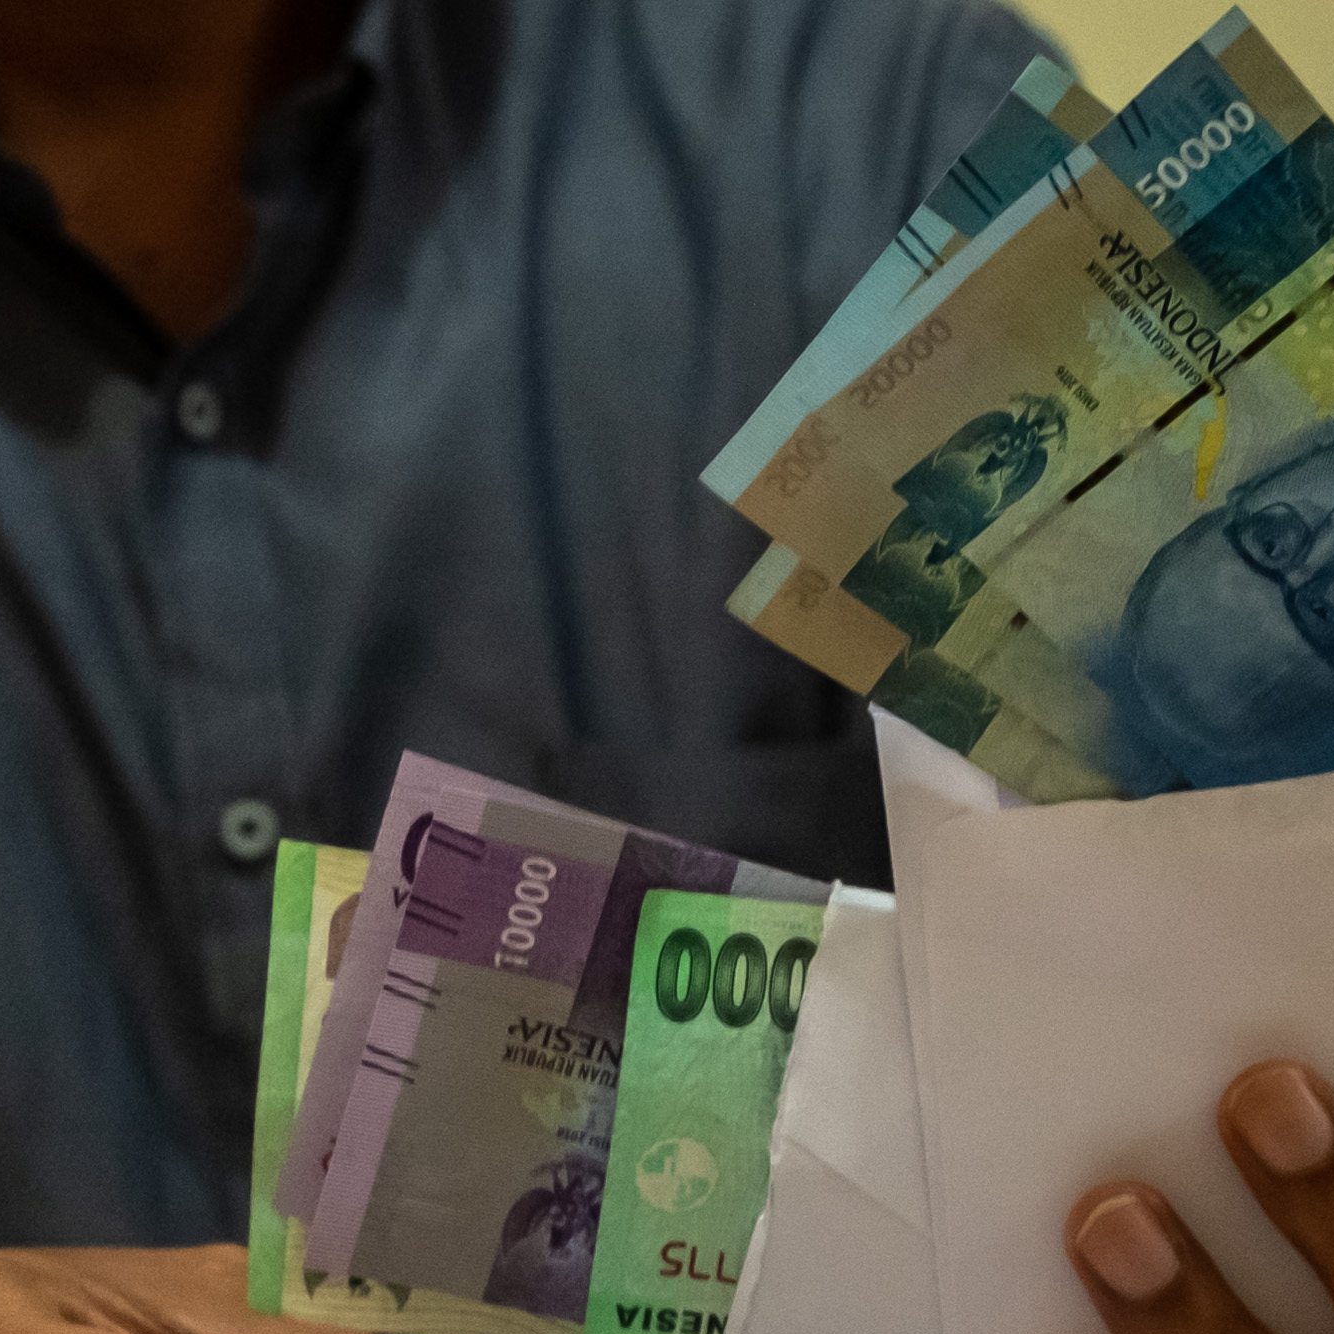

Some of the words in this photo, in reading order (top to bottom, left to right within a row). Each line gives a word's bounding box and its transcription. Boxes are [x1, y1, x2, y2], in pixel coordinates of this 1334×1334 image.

[1135, 100, 1256, 211] 50000
[1083, 257, 1134, 314] REPUBLIK
[1098, 228, 1244, 397] INDONESIA
[850, 315, 954, 409] 20000
[1126, 304, 1180, 364] KESATUAN
[1171, 356, 1203, 389] GARA
[495, 856, 557, 971] 10000
[655, 928, 819, 1033] 000
[502, 1046, 575, 1079] REPUBLIK
[508, 1016, 622, 1066] NESIA
[573, 1056, 619, 1088] TUAN
[659, 1241, 738, 1285] 775
